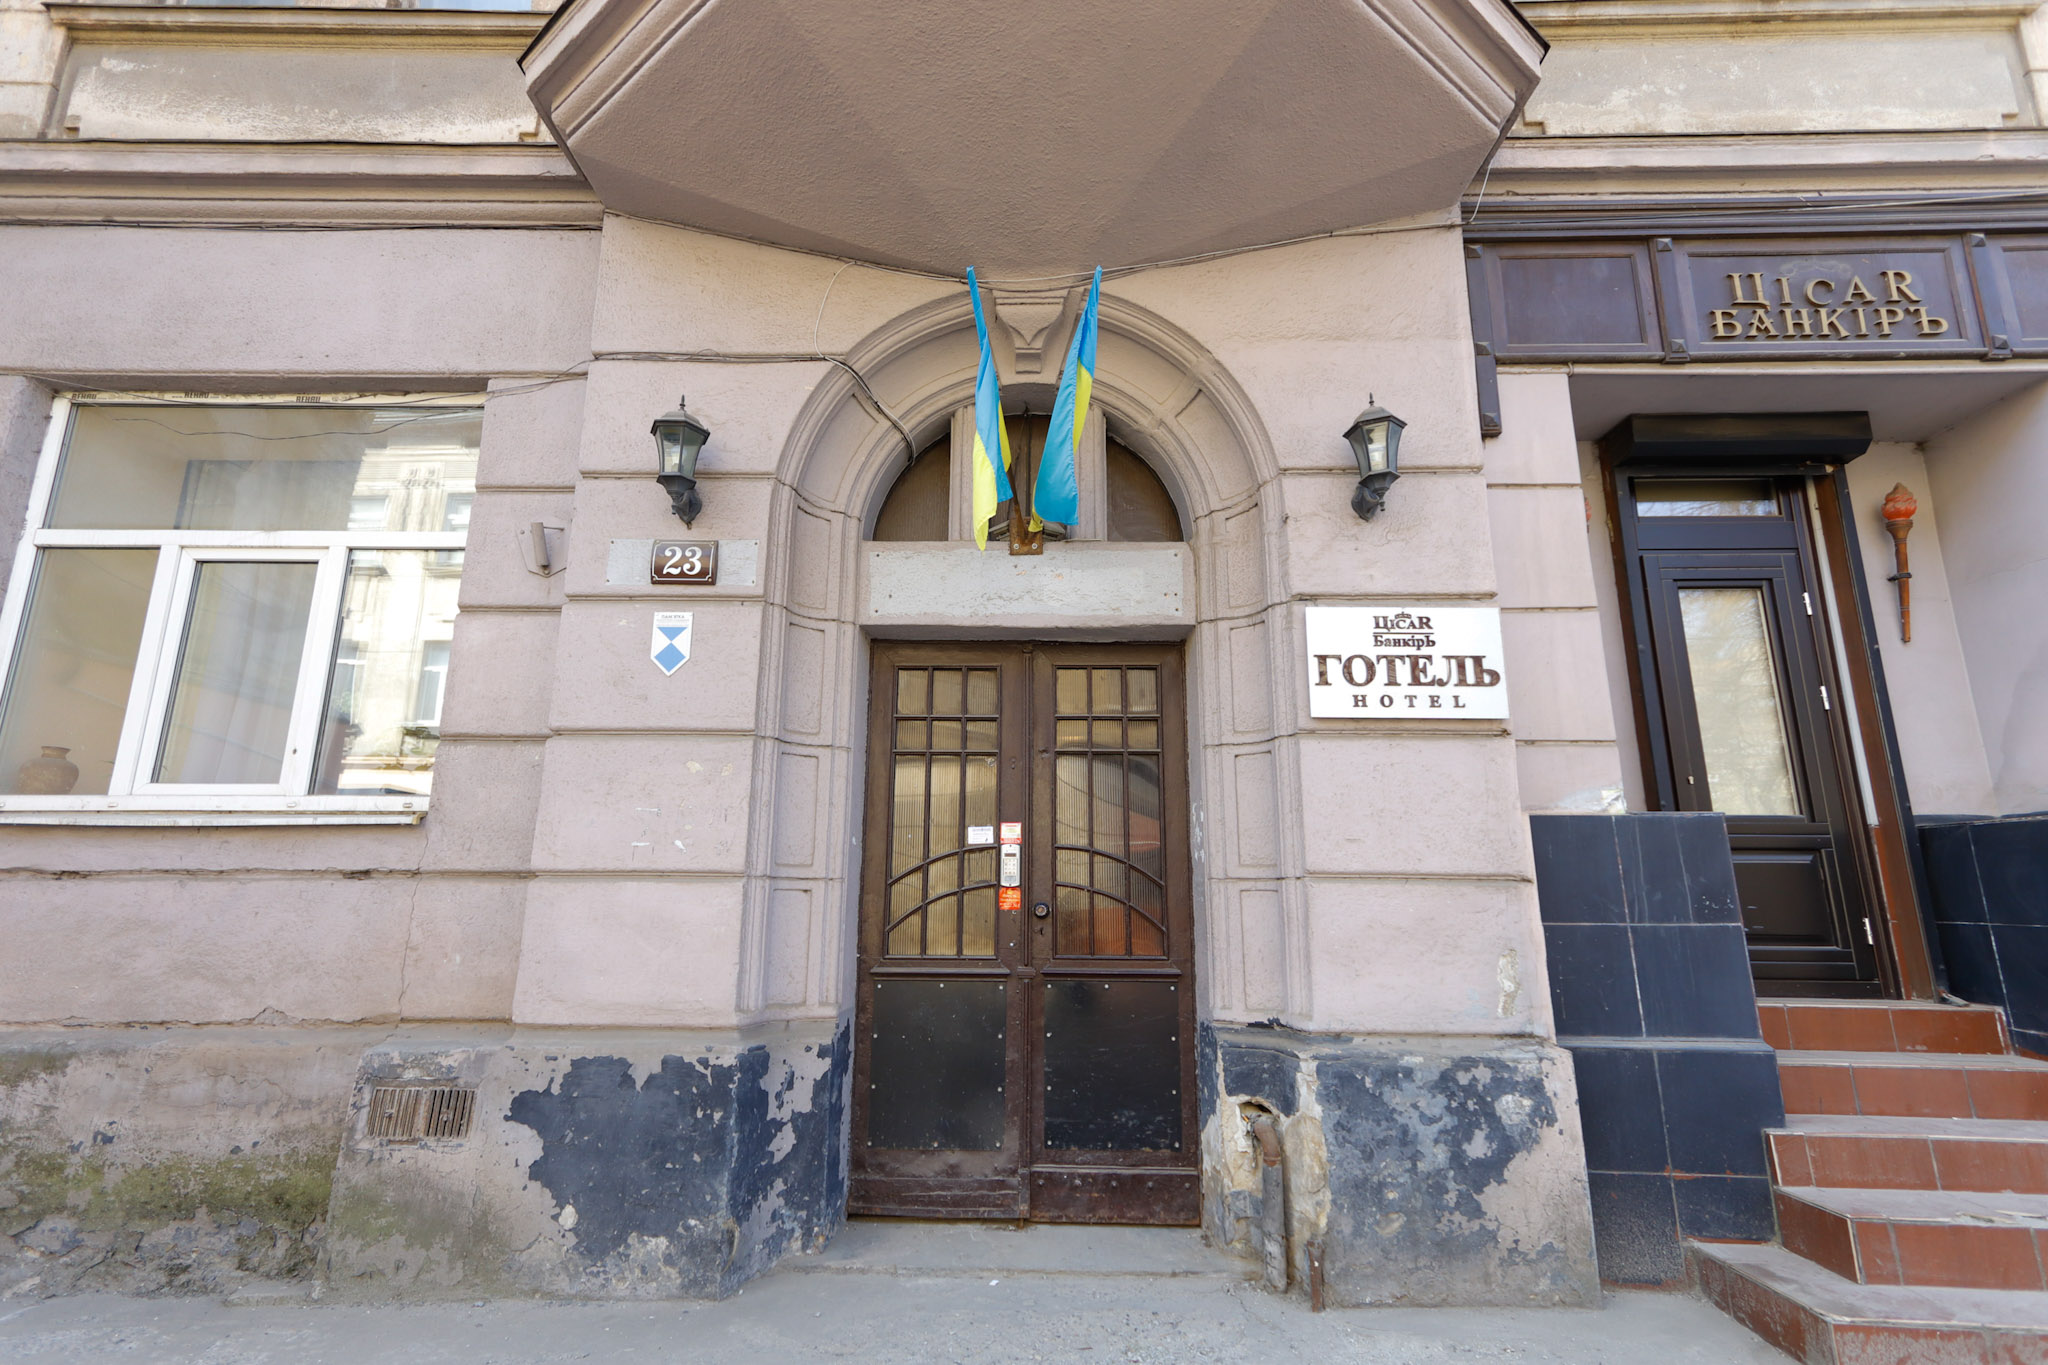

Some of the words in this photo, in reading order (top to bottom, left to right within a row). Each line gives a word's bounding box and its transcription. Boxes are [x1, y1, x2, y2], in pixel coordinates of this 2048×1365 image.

[296, 395, 321, 403] REHAU
[662, 546, 702, 575] 23
[1313, 654, 1501, 687] ГОТЕЛЬ
[1352, 694, 1466, 708] HOTEL
